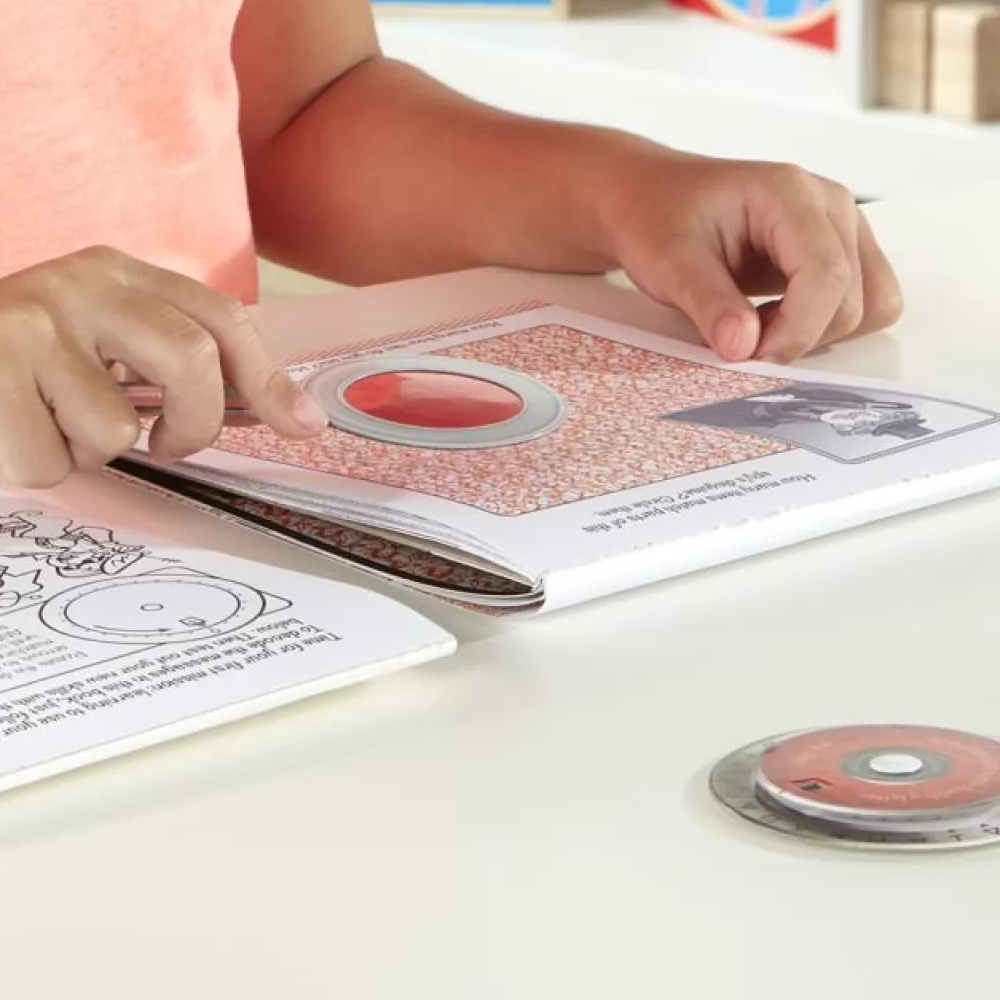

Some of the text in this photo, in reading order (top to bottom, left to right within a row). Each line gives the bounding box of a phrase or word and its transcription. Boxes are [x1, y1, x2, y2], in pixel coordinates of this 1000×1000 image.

[301, 632, 342, 645] Time
[279, 642, 304, 653] for
[244, 647, 278, 664] your
[208, 660, 244, 675] first
[146, 670, 208, 691] mission:
[80, 688, 151, 710] learning
[37, 713, 66, 724] use
[65, 707, 86, 716] to
[2, 718, 38, 736] your
